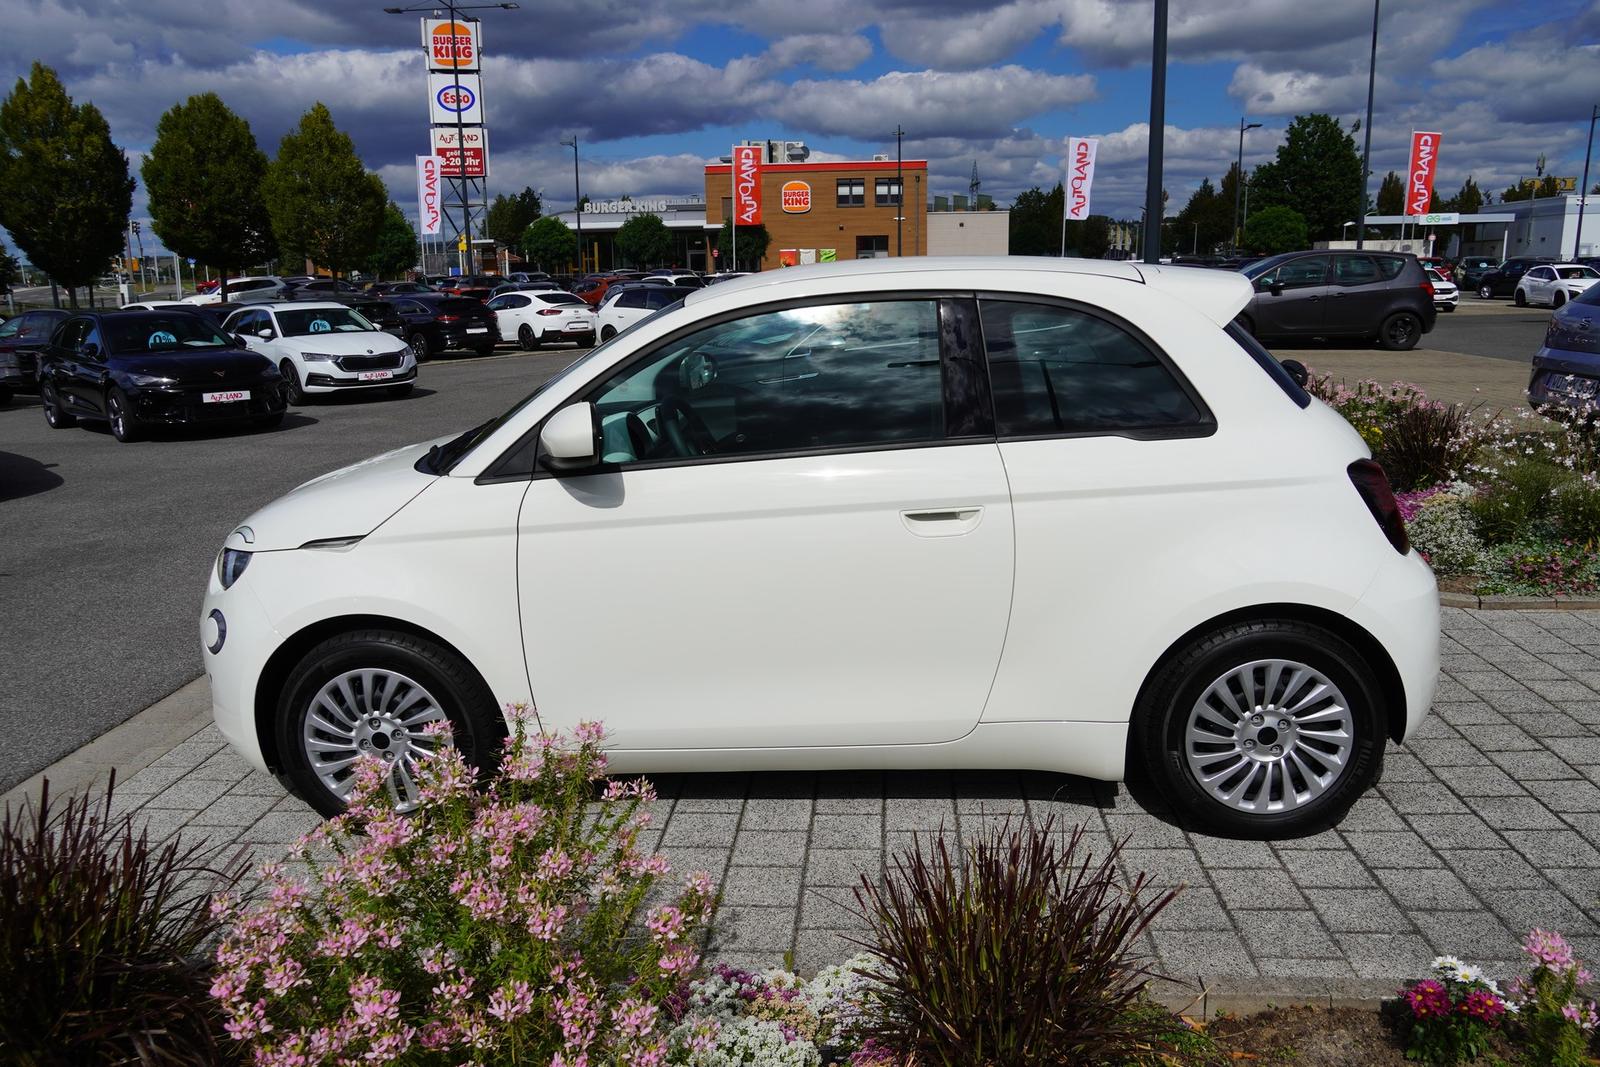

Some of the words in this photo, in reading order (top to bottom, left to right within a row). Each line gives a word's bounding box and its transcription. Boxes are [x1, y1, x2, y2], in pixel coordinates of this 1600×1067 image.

[433, 36, 472, 46] BURGER
[433, 46, 473, 58] KING
[440, 134, 479, 144] AUTOAND
[738, 149, 758, 223] AUTOLAND
[1070, 142, 1091, 217] AUTOLAND
[424, 160, 439, 231] AUTOLAND
[783, 197, 810, 206] KING
[584, 200, 634, 214] BURGER
[635, 200, 667, 213] KING
